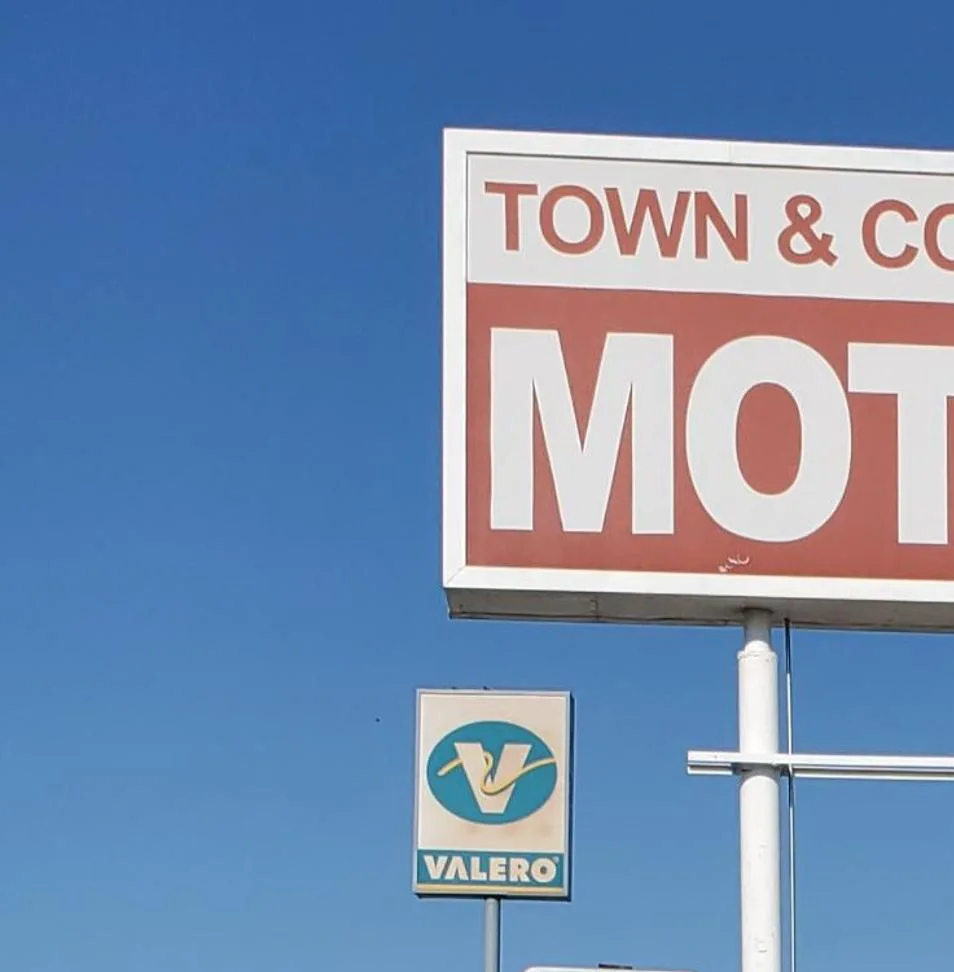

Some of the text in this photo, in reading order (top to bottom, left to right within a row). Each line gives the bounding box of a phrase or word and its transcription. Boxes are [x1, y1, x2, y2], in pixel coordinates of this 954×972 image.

[484, 181, 749, 262] TOWN
[777, 193, 839, 266] &
[423, 854, 557, 883] VALERO
